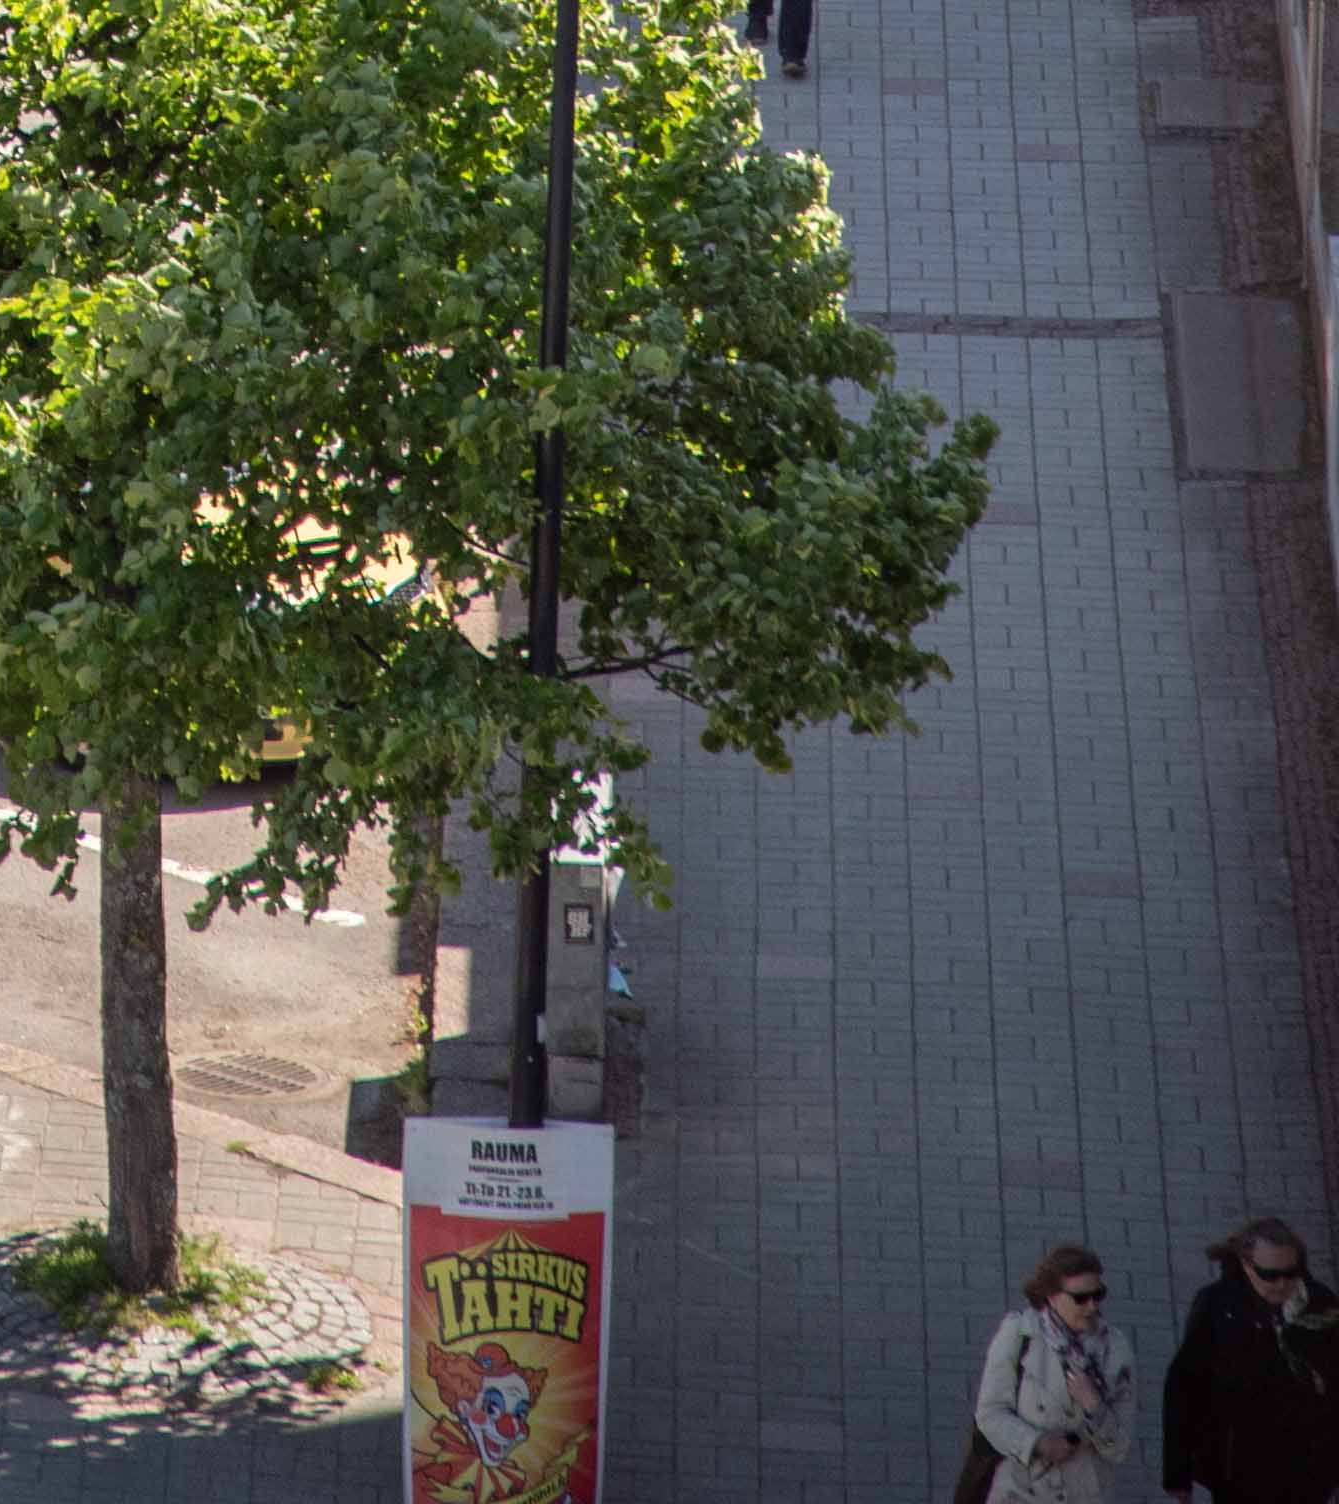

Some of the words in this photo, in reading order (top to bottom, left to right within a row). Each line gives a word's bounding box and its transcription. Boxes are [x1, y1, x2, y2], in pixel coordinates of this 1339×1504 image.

[471, 1139, 538, 1164] RAUMA
[425, 1256, 585, 1344] TÄHTI
[491, 1252, 588, 1301] SIRKUS
